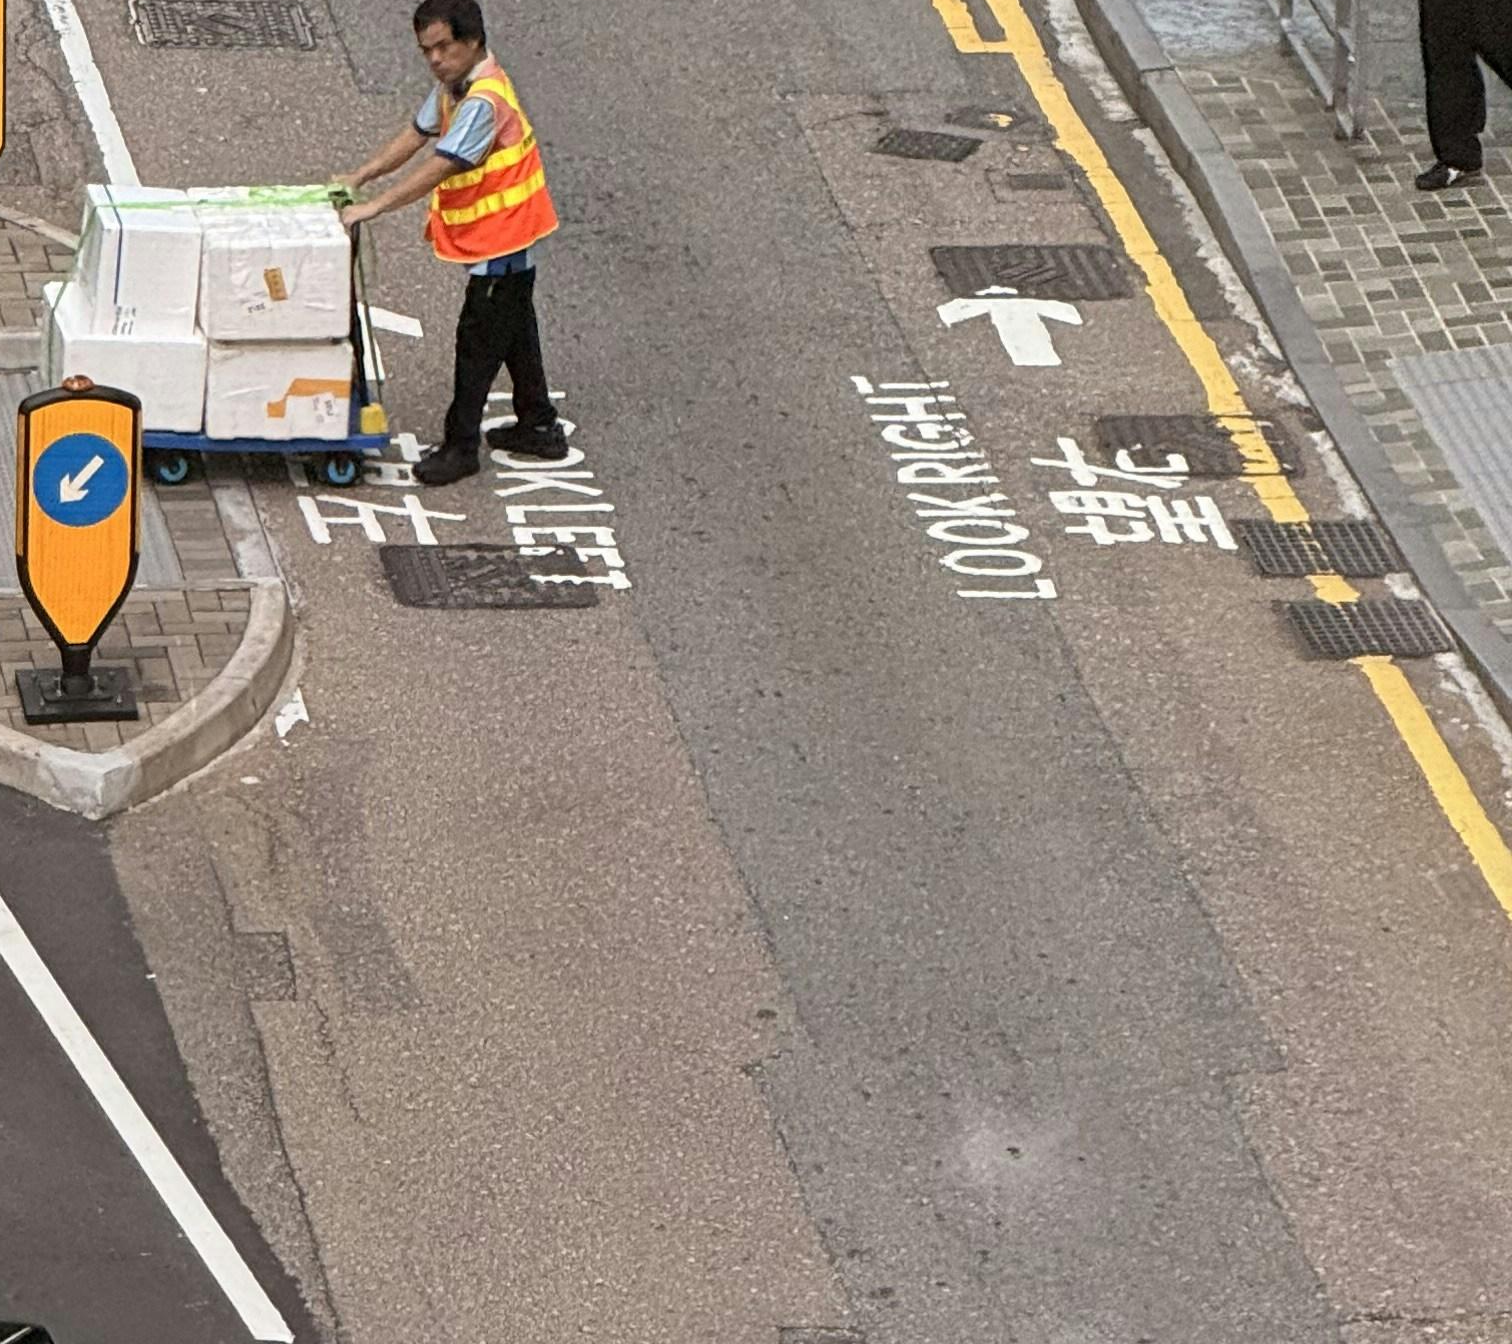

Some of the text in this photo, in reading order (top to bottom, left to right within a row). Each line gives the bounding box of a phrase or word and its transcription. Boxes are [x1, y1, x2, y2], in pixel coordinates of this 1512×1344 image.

[850, 376, 1057, 599] LOOK RIGHT
[1030, 437, 1239, 550] 望右
[506, 504, 631, 589] LEFT
